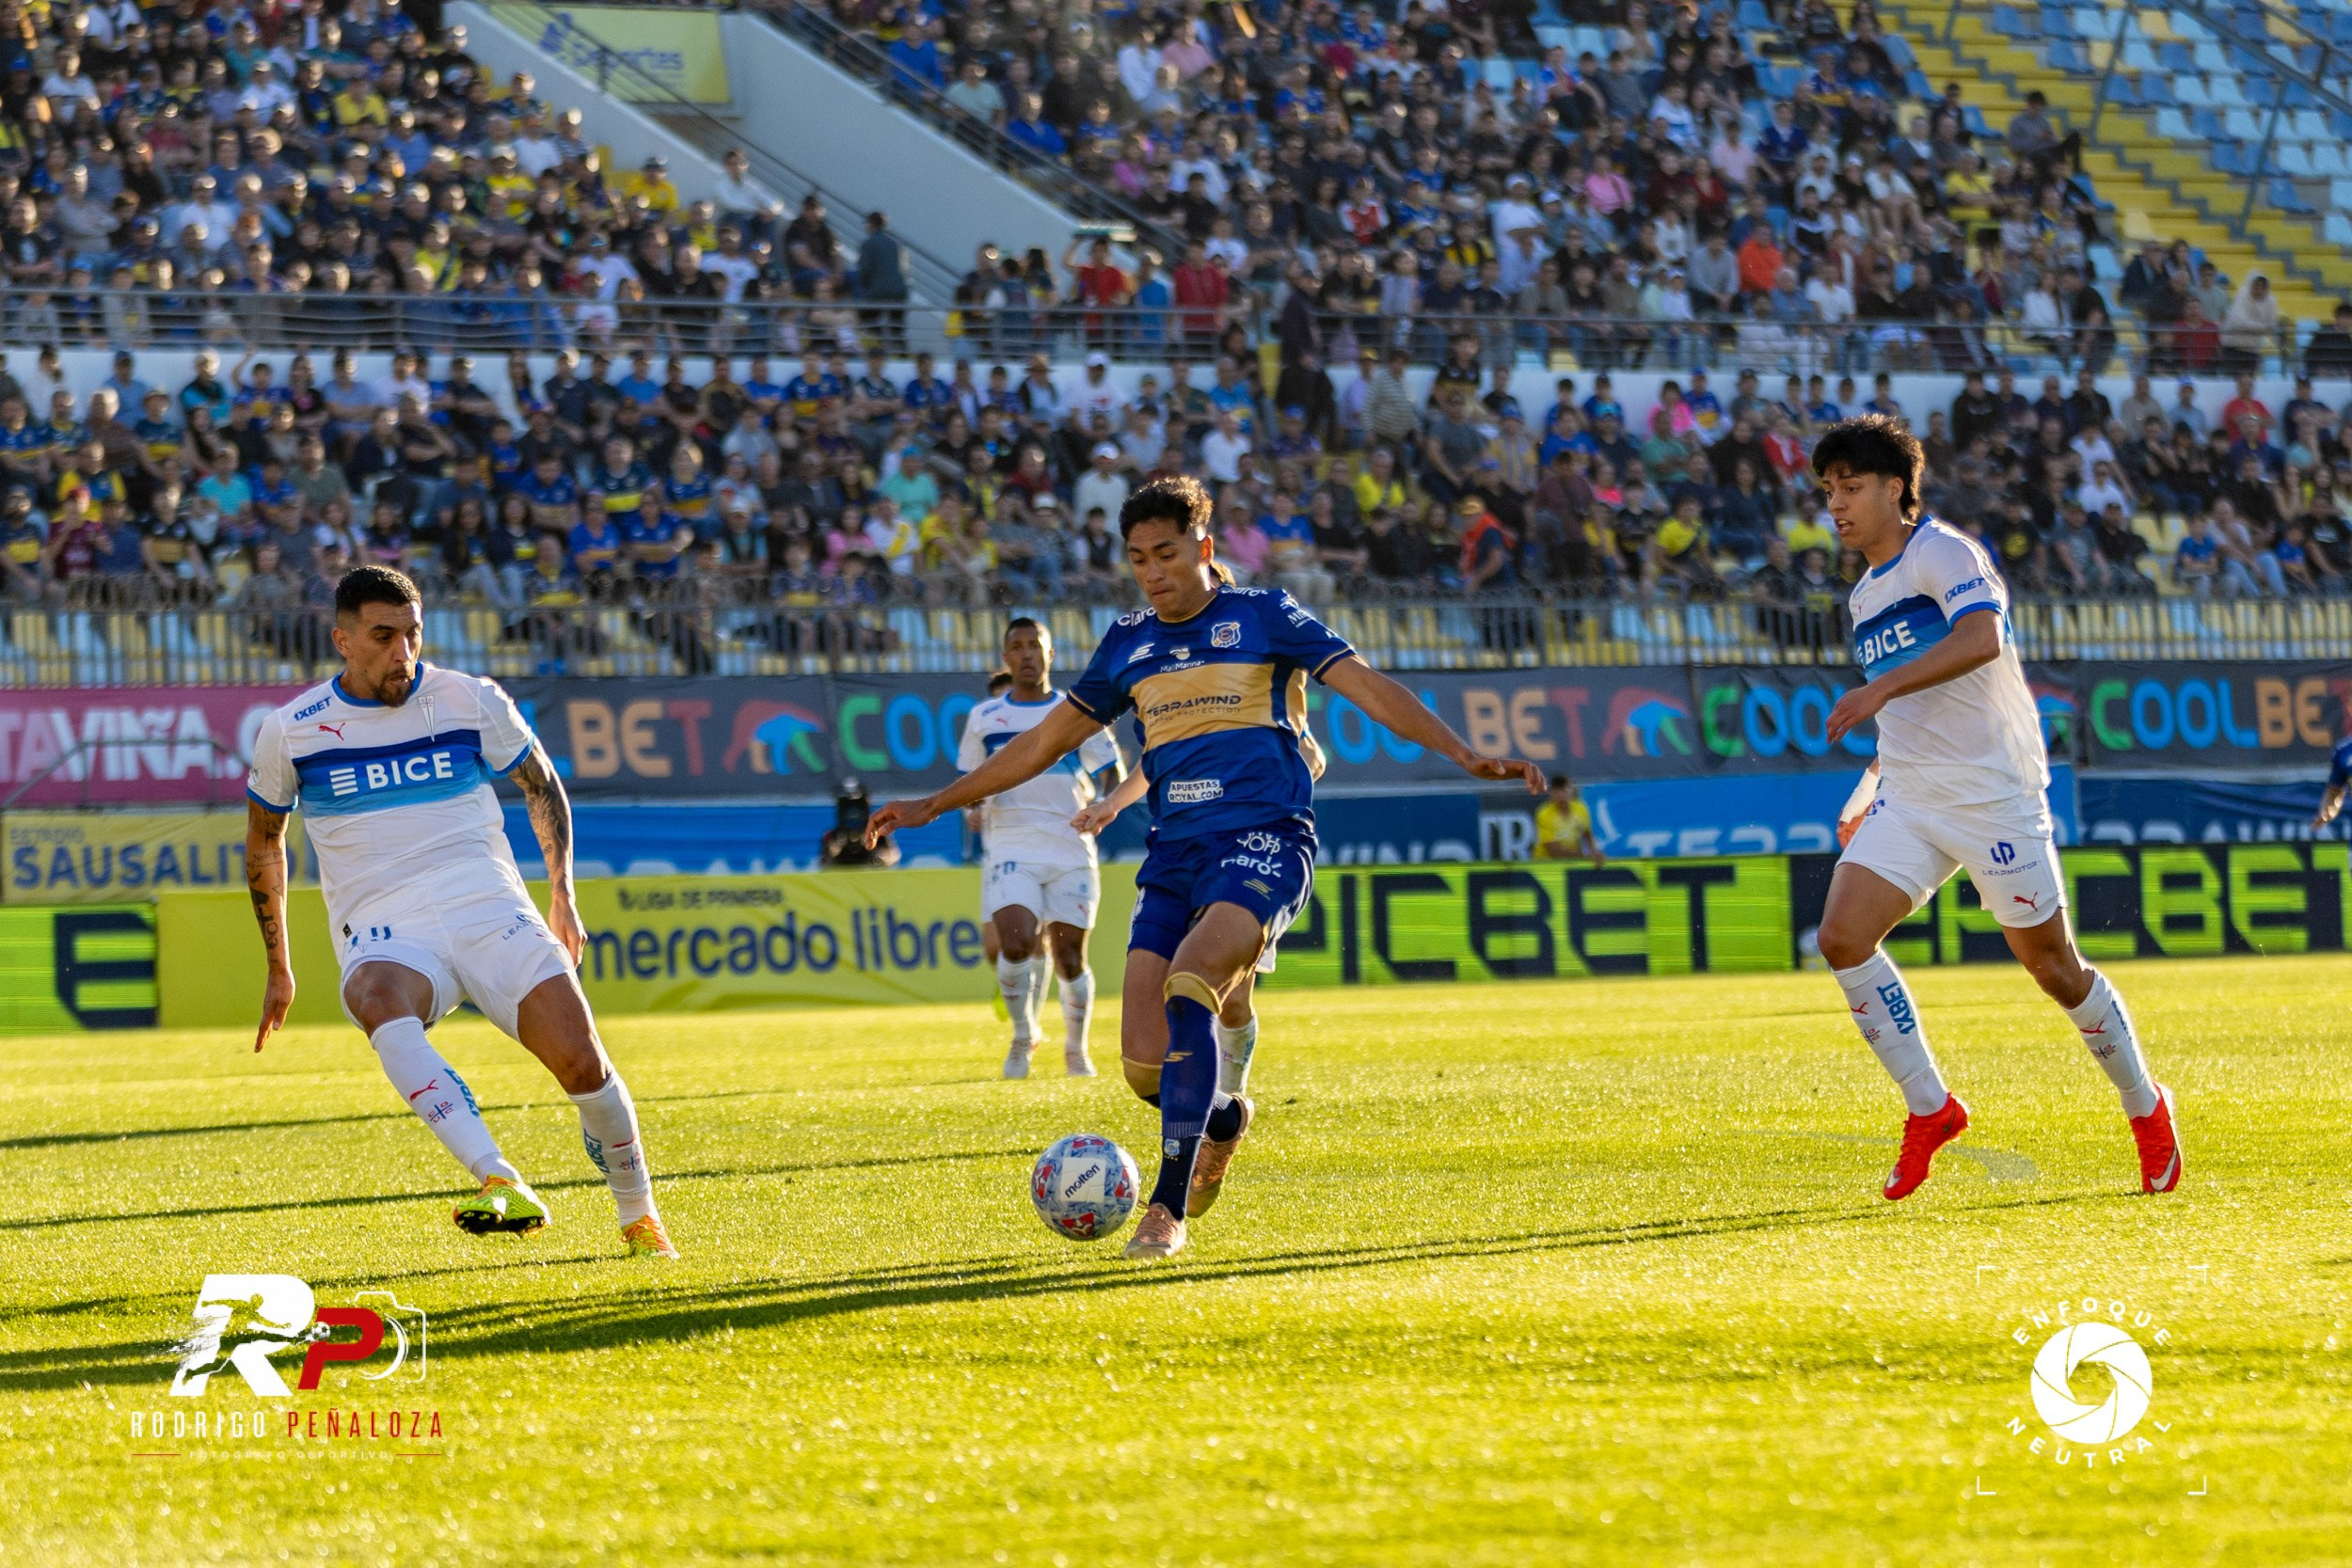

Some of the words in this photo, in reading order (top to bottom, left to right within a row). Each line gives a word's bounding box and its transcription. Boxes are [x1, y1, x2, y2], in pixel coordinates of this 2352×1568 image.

[1944, 577, 1987, 604] 1XBET
[1117, 607, 1156, 627] Claro
[1864, 620, 1917, 666] BICE
[294, 696, 331, 721] 1XBET
[1147, 694, 1242, 720] TERRAWIND
[366, 752, 453, 790] BICE
[1169, 788, 1223, 801] ROYAL.COM
[1170, 781, 1218, 792] APUESTAS
[1982, 861, 2039, 877] LEAPMOTOR
[578, 909, 839, 981] mercado
[851, 905, 983, 972] libre
[1064, 1163, 1101, 1199] molten
